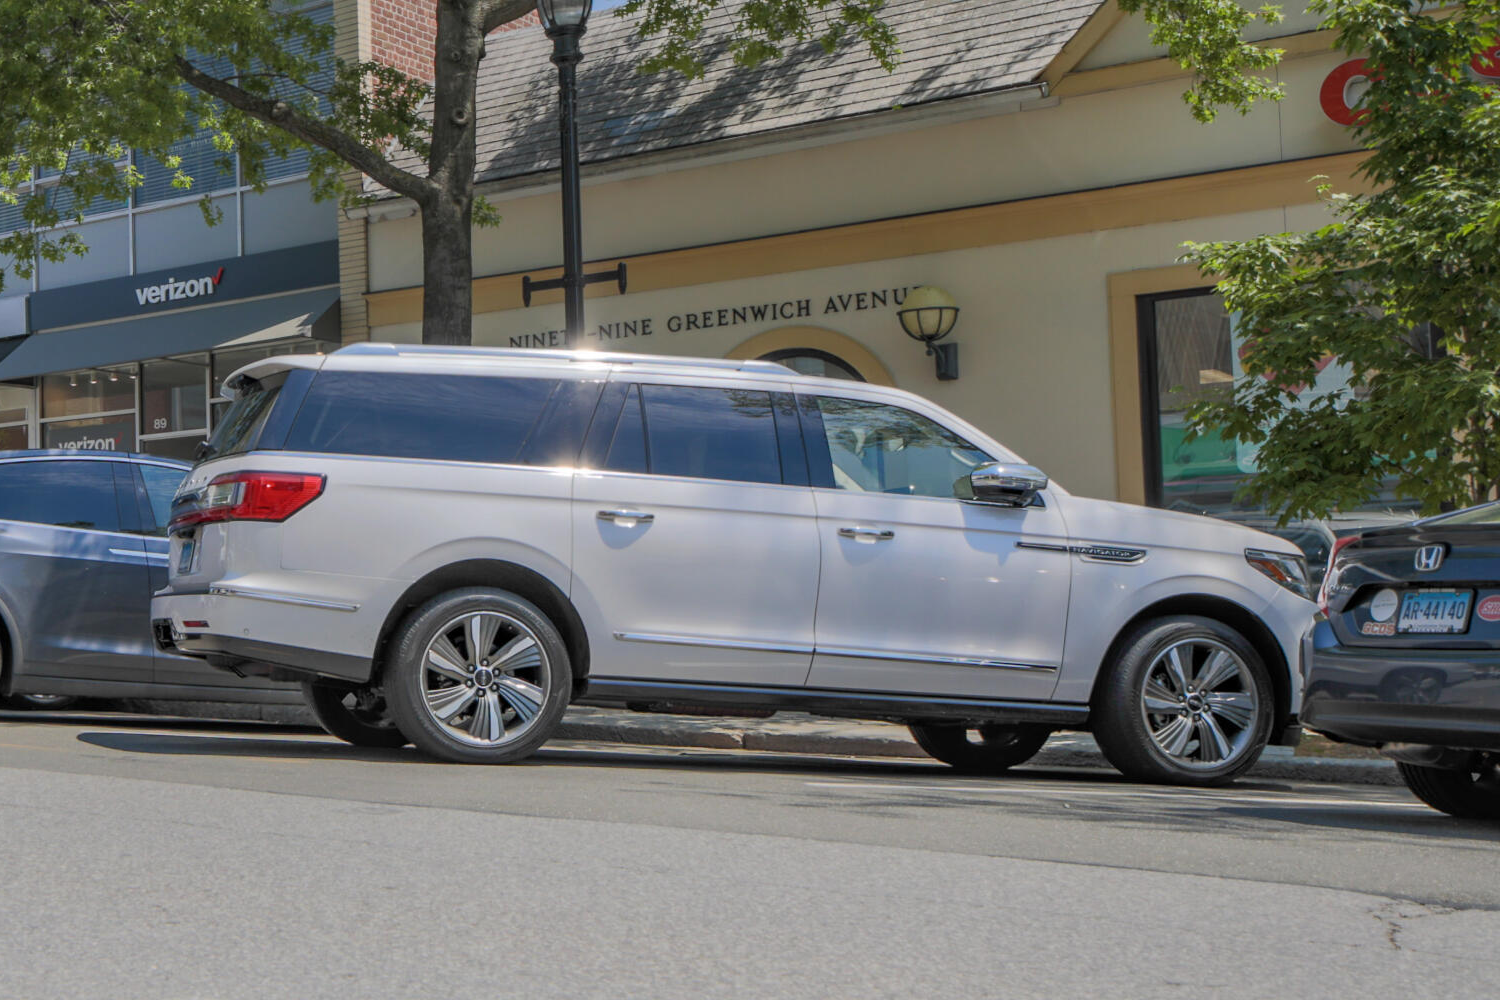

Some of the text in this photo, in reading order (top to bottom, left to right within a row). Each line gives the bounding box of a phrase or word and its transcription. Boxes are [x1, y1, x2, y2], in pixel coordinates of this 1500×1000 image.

[135, 277, 214, 305] verizon
[509, 286, 922, 348] NINET-NINE GREENWICH AVENU
[153, 417, 167, 430] 89
